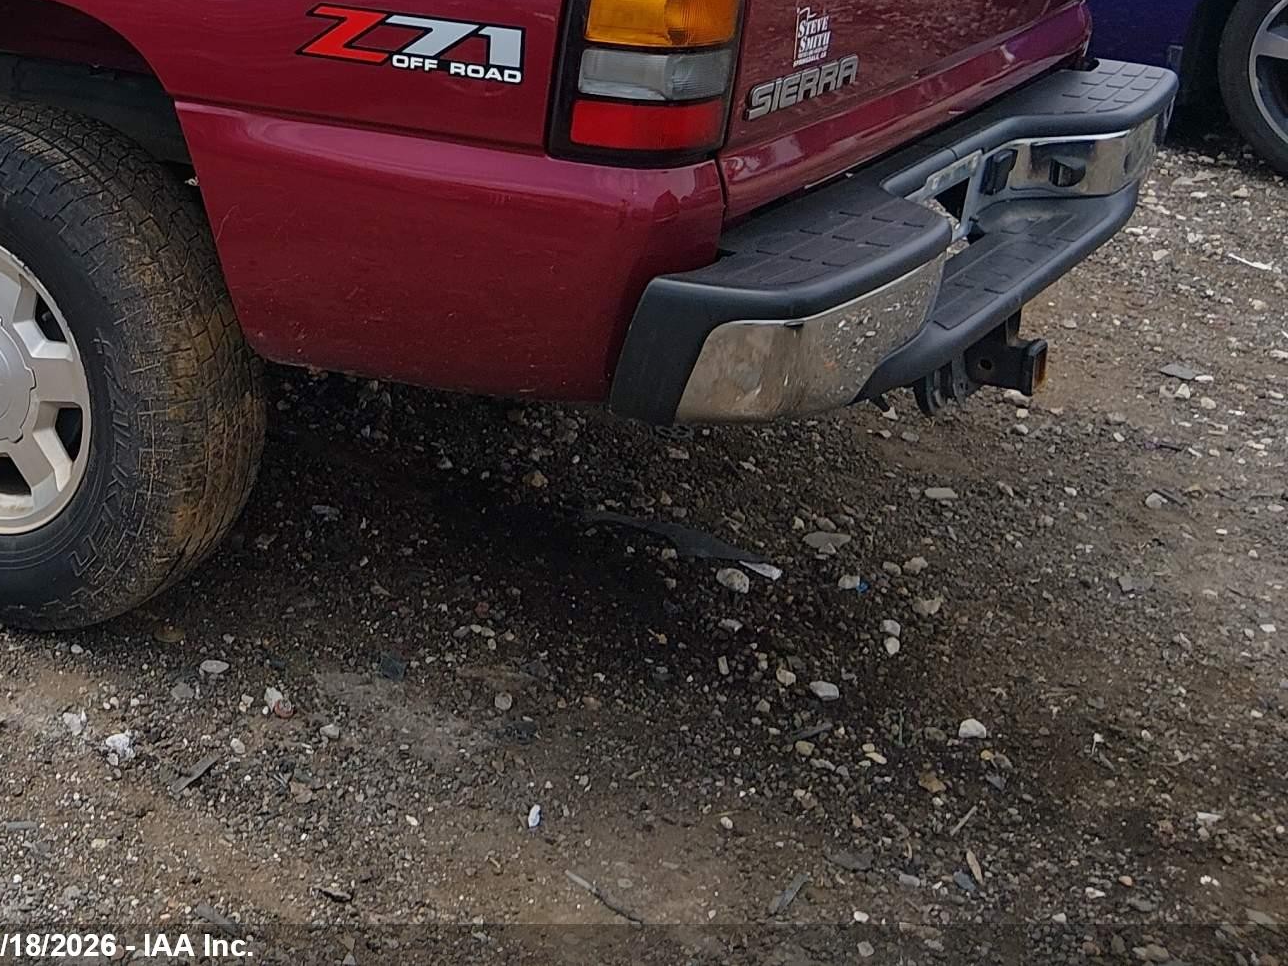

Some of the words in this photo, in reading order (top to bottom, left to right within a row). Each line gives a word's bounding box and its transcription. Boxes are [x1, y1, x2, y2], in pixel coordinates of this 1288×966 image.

[298, 3, 525, 66] Z71
[797, 15, 830, 39] STEVE
[799, 31, 831, 52] SMITH
[391, 54, 438, 71] OFF
[449, 63, 521, 84] ROAD
[744, 54, 858, 121] SIERRA
